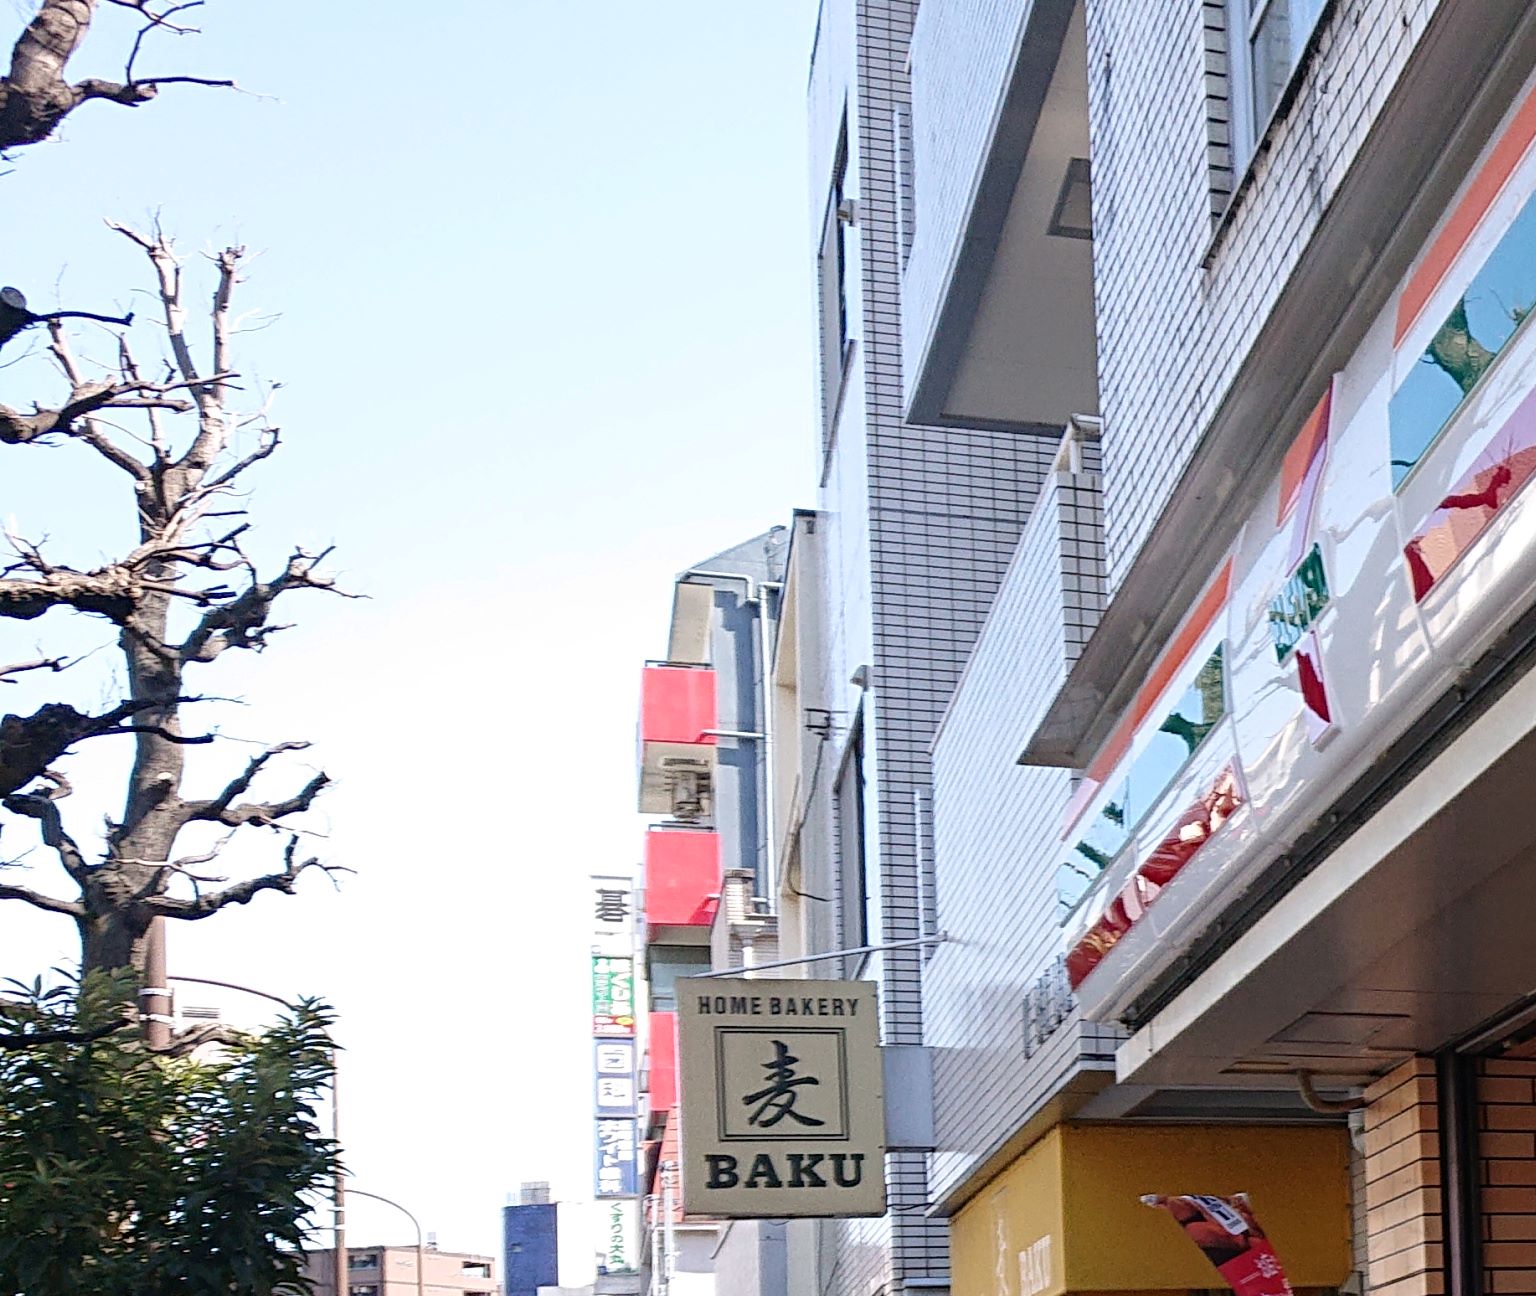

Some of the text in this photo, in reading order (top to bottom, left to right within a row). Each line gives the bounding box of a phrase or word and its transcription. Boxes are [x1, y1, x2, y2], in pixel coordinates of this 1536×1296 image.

[697, 996, 859, 1017] HOME BAKERY
[742, 1040, 825, 1127] 麦
[704, 1153, 865, 1188] BAKU
